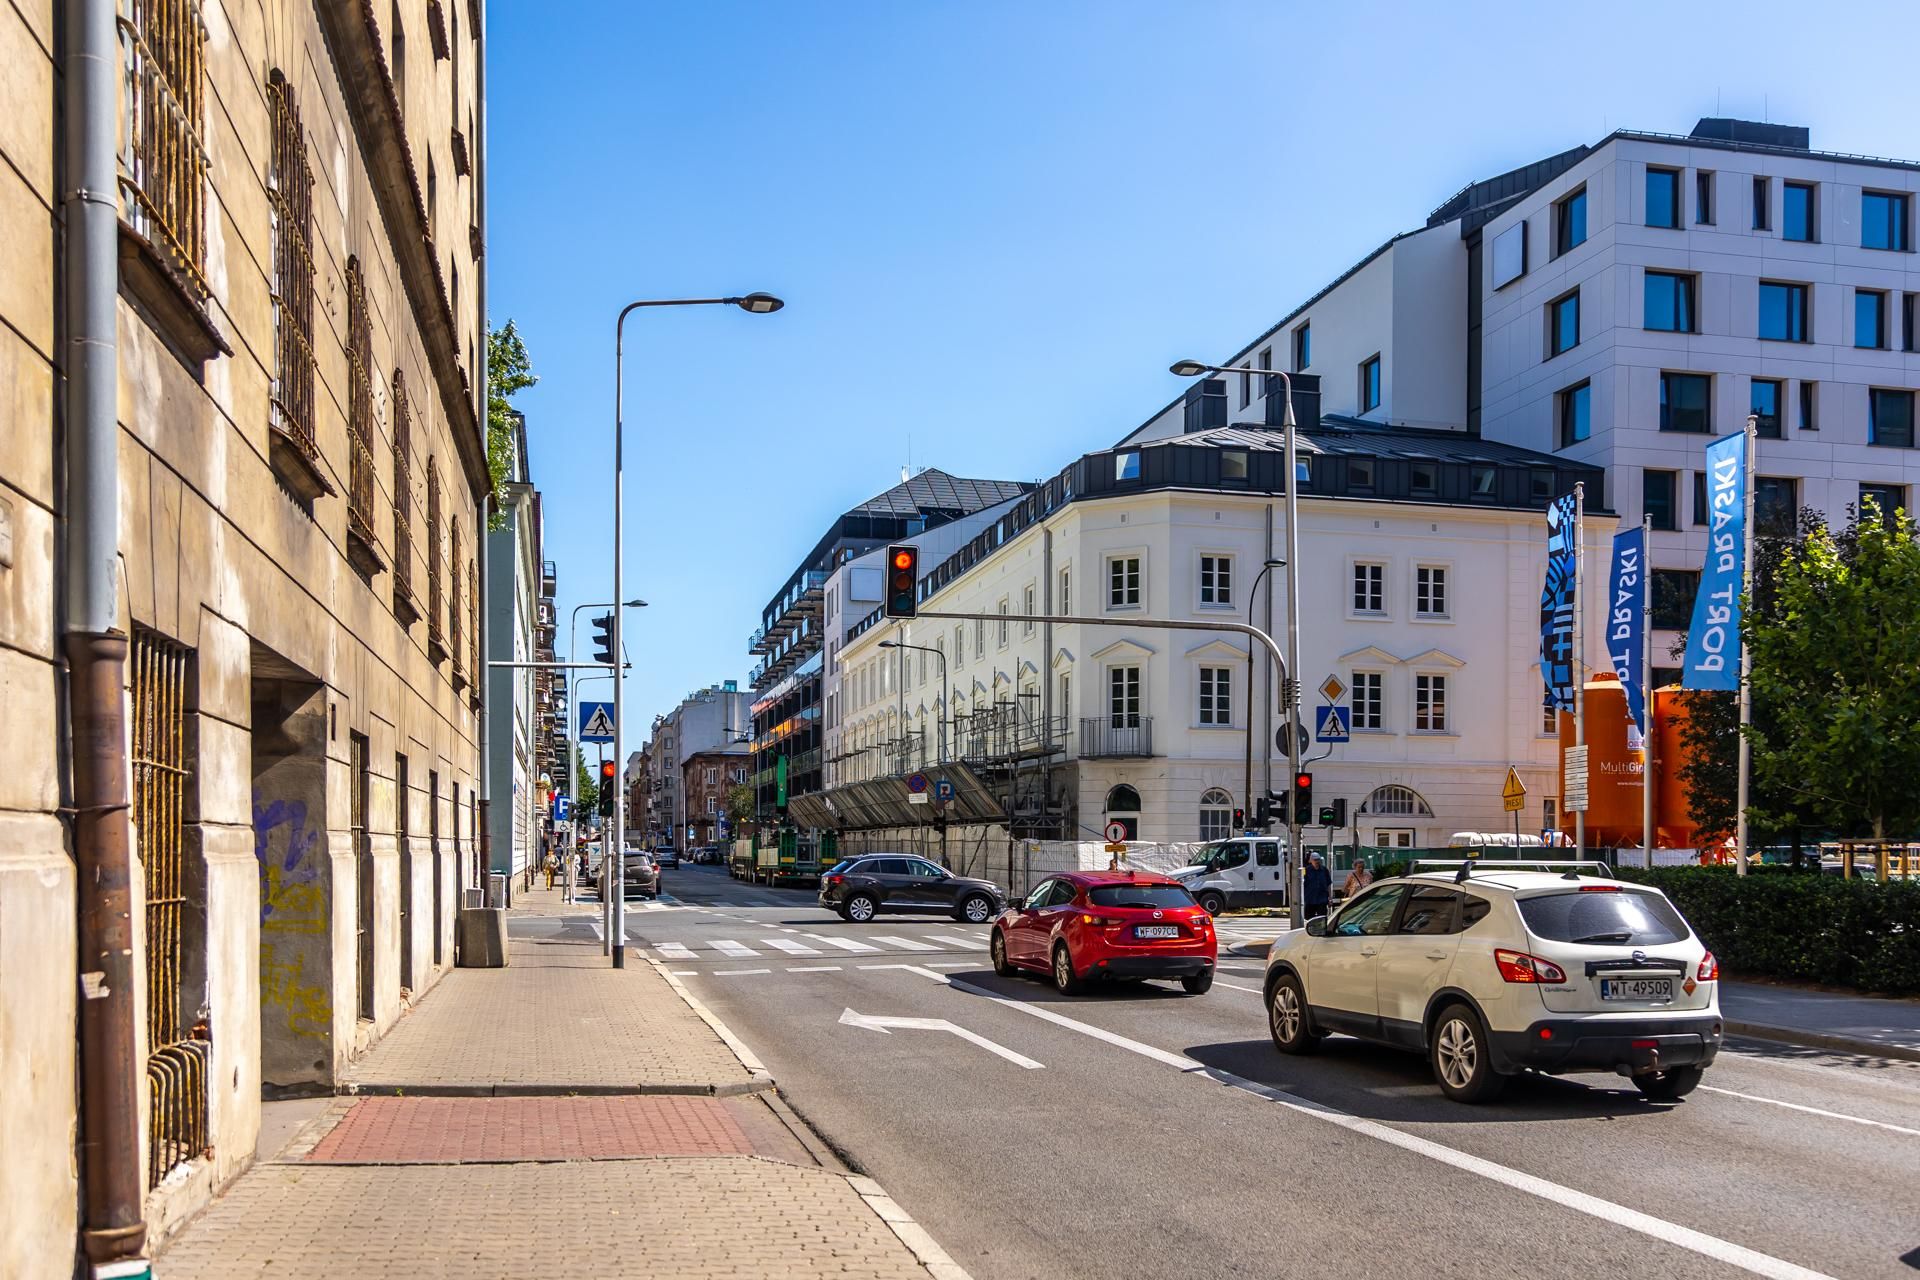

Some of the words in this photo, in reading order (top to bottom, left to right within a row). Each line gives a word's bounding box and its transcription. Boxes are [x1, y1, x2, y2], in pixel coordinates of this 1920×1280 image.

[1600, 761, 1645, 774] MultiGip
[1505, 798, 1522, 808] PIESI
[1139, 927, 1150, 936] WF
[1610, 981, 1628, 995] WT
[1633, 981, 1670, 995] 49509
